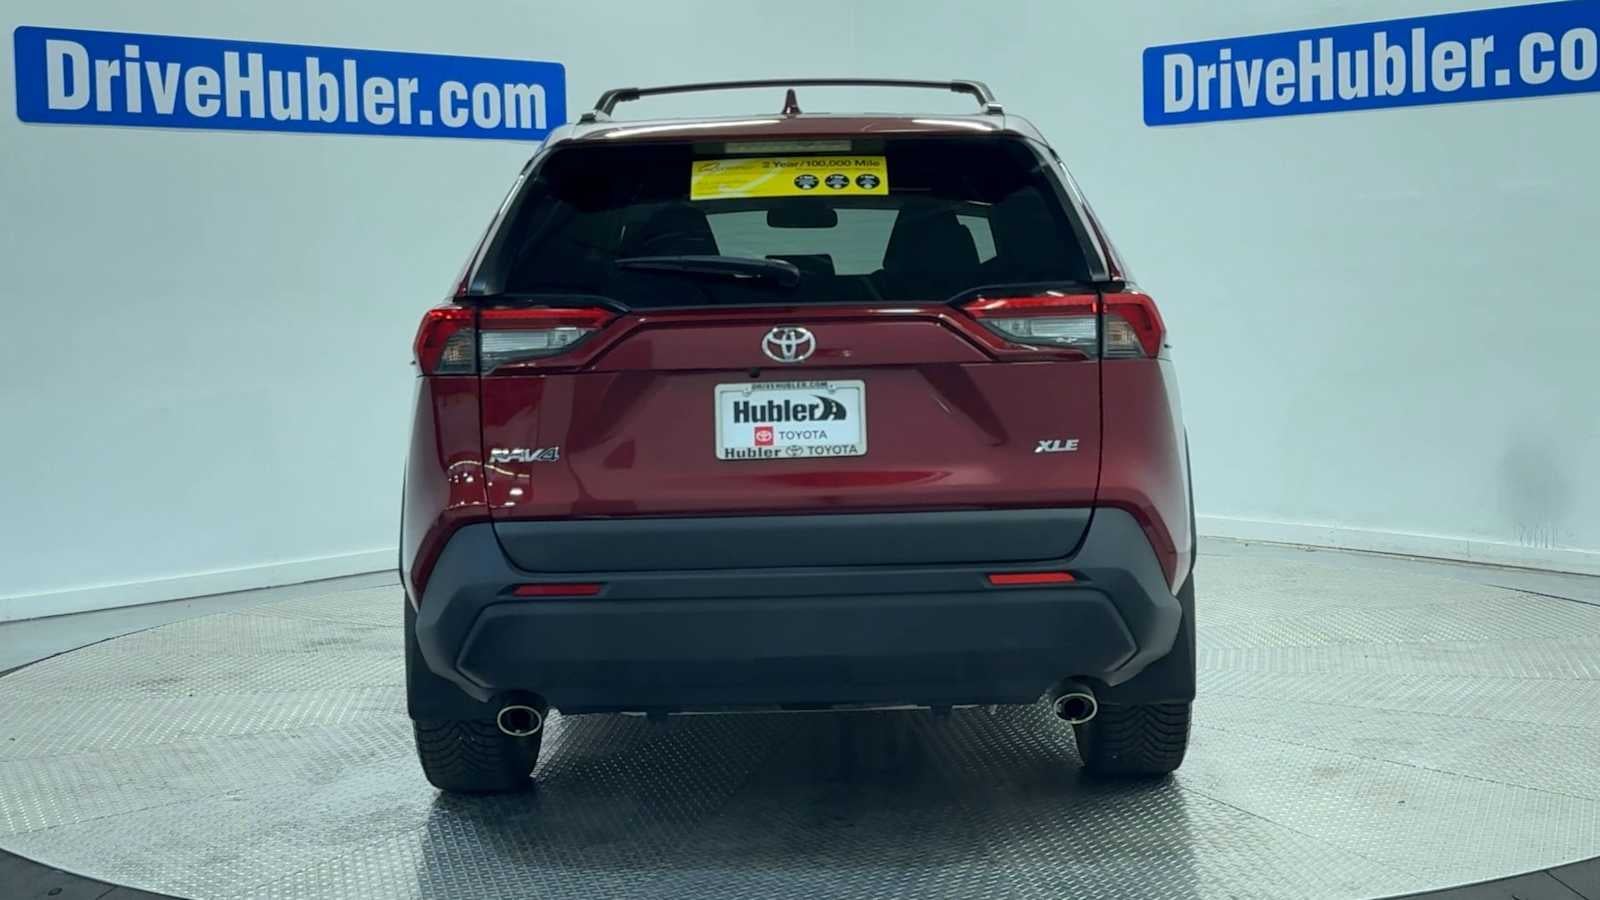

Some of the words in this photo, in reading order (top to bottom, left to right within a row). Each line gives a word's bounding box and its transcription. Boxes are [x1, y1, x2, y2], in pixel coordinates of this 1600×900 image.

[45, 39, 548, 129] DriveHubler.com
[762, 161, 769, 169] 2
[770, 159, 853, 168] Year/100,000
[855, 158, 880, 168] Mile
[751, 382, 829, 390] DRIVEHUBLER.COM
[733, 399, 820, 423] Hubler
[778, 430, 828, 440] TOYOTA
[724, 447, 782, 458] Hubler
[807, 444, 858, 456] TOYOTA
[1034, 439, 1080, 453] XLE
[489, 446, 560, 463] RAV4
